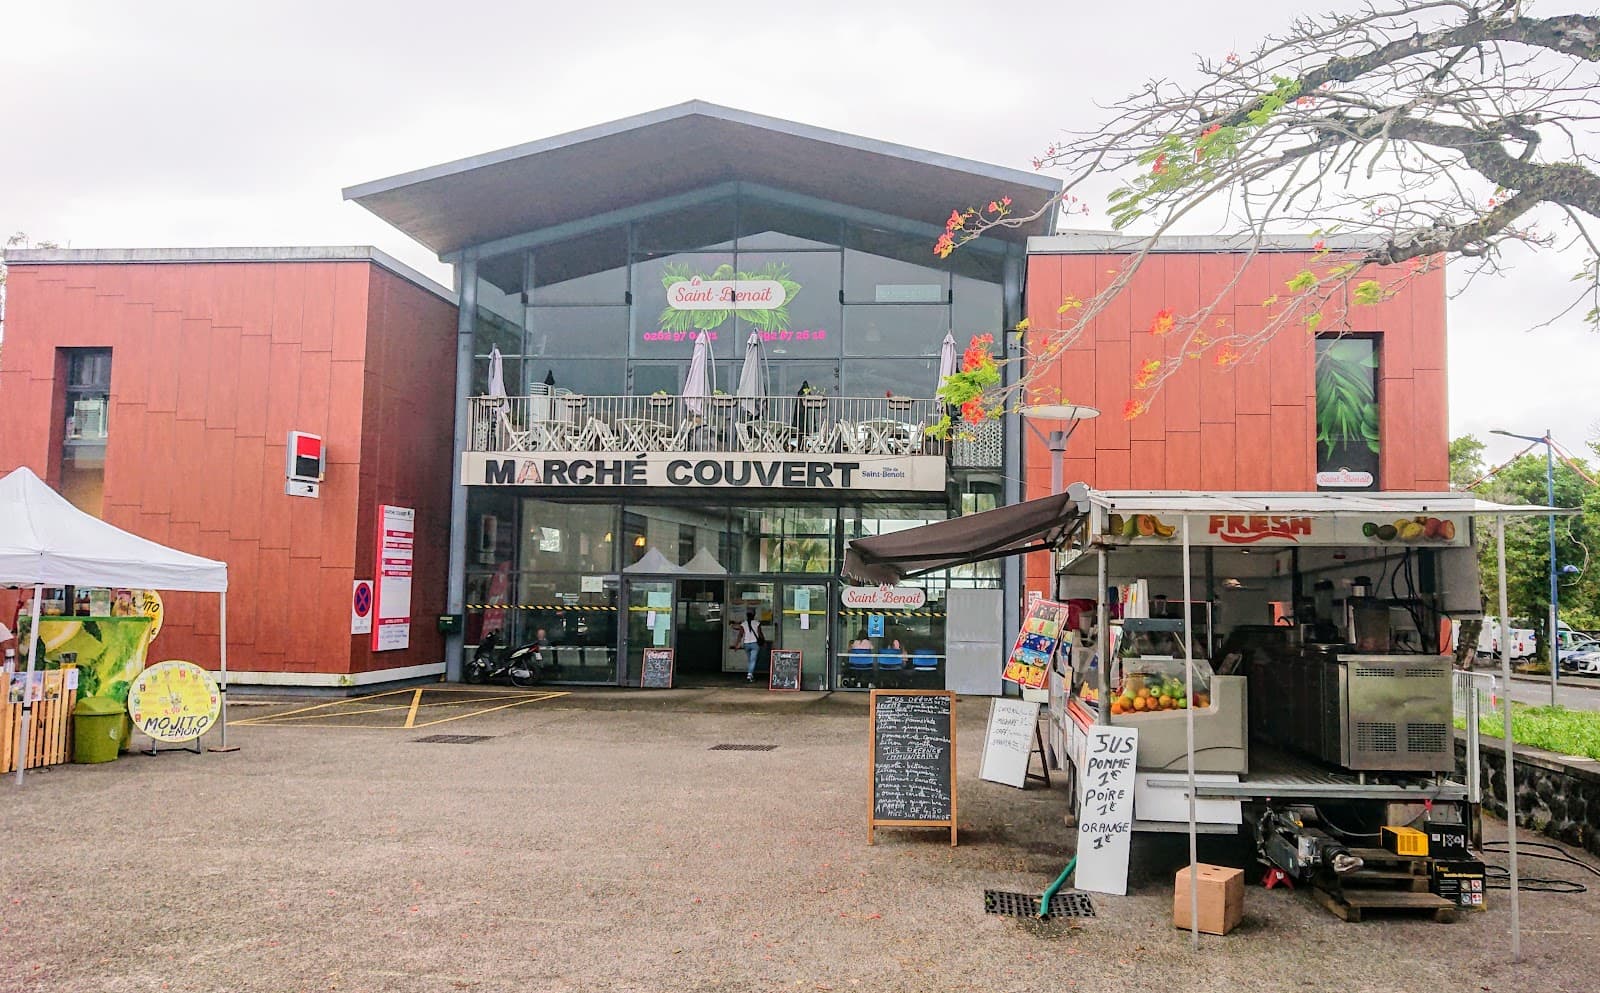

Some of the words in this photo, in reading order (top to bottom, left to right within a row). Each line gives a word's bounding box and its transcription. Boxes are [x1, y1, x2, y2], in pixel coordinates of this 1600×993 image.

[485, 453, 648, 485] MARCHÉ
[666, 459, 860, 488] COUVERT
[1208, 515, 1312, 535] FRESH
[144, 715, 209, 731] MOJITO
[160, 728, 201, 737] LEMON
[1093, 733, 1135, 753] JUS
[1087, 757, 1131, 776] POMME
[1081, 822, 1130, 833] ORANGE
